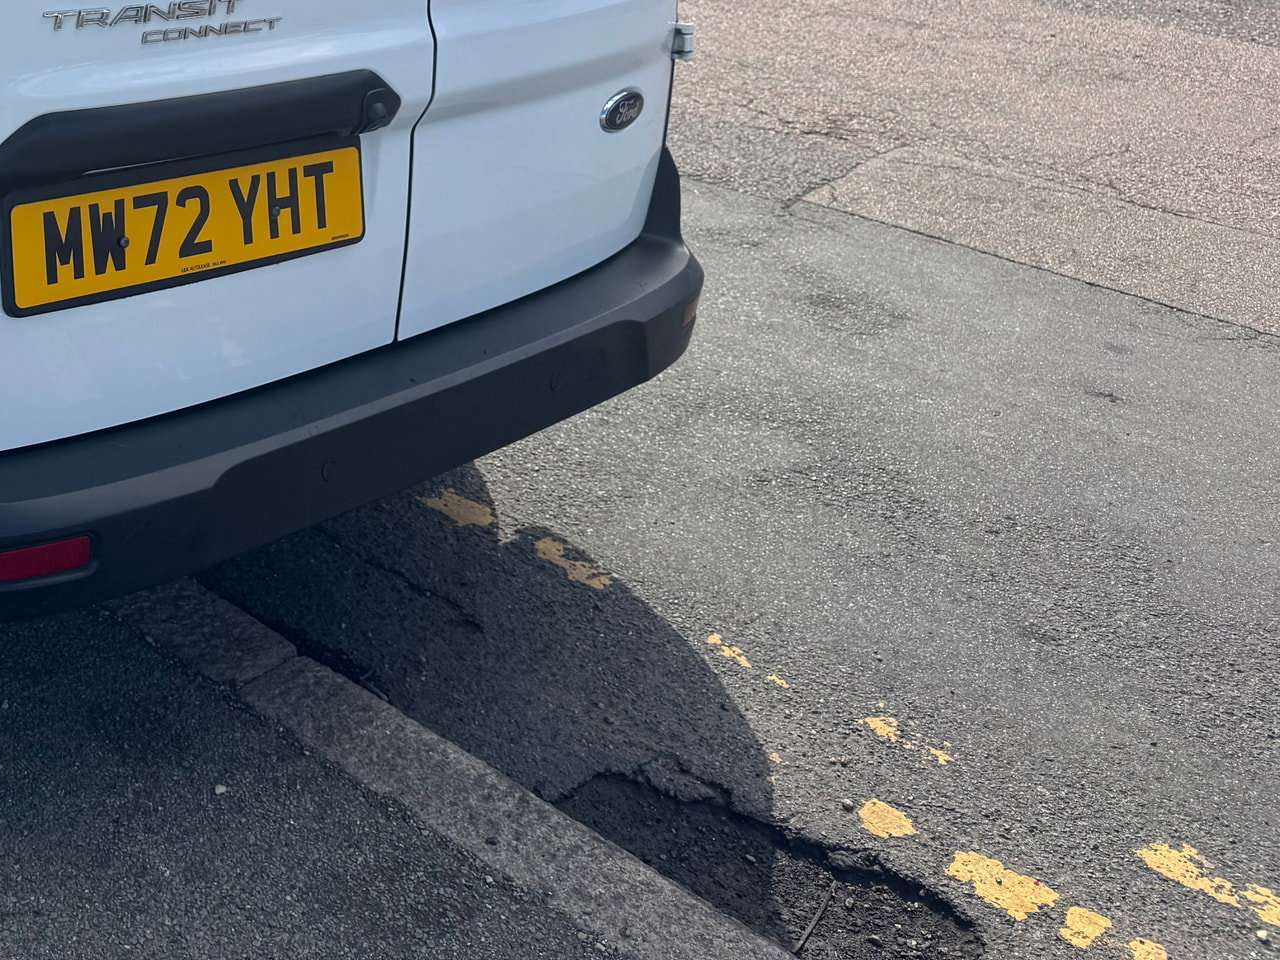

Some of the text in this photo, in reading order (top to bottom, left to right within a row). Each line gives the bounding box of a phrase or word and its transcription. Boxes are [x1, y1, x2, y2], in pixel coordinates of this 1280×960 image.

[141, 16, 283, 45] CONNECT
[42, 160, 335, 286] MW72 YHT
